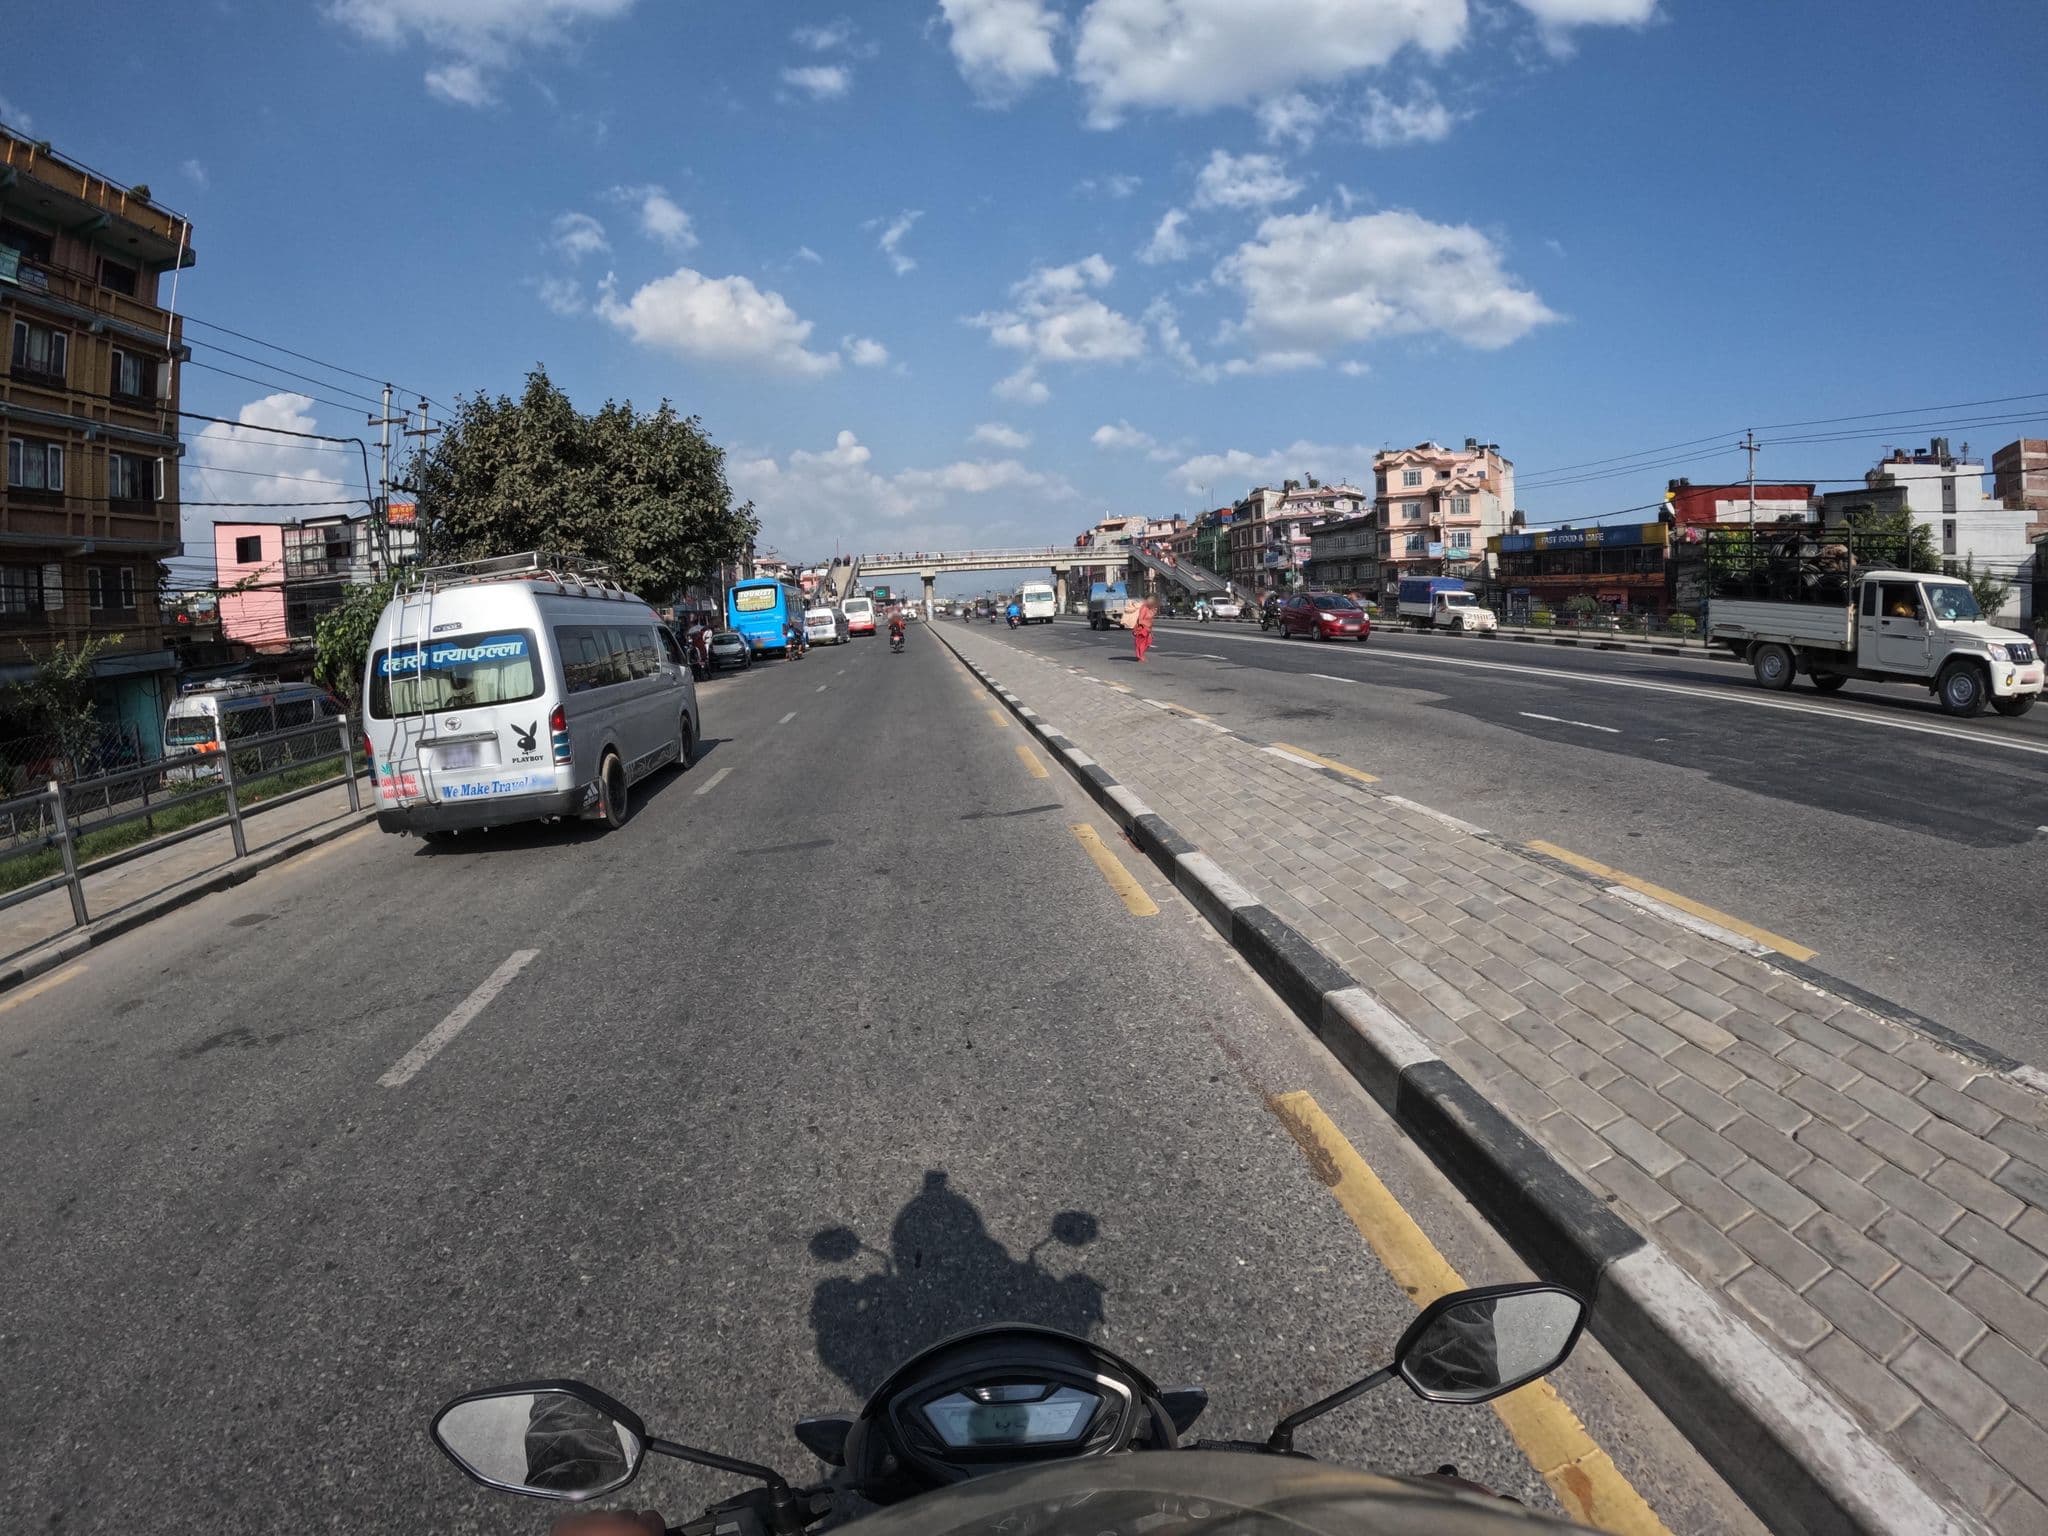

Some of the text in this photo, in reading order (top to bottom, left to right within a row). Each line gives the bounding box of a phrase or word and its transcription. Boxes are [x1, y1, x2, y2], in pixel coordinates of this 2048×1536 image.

[1558, 535, 1577, 543] FOOD
[512, 755, 543, 763] PLAYBOY
[442, 786, 458, 798] We
[460, 783, 490, 797] Make
